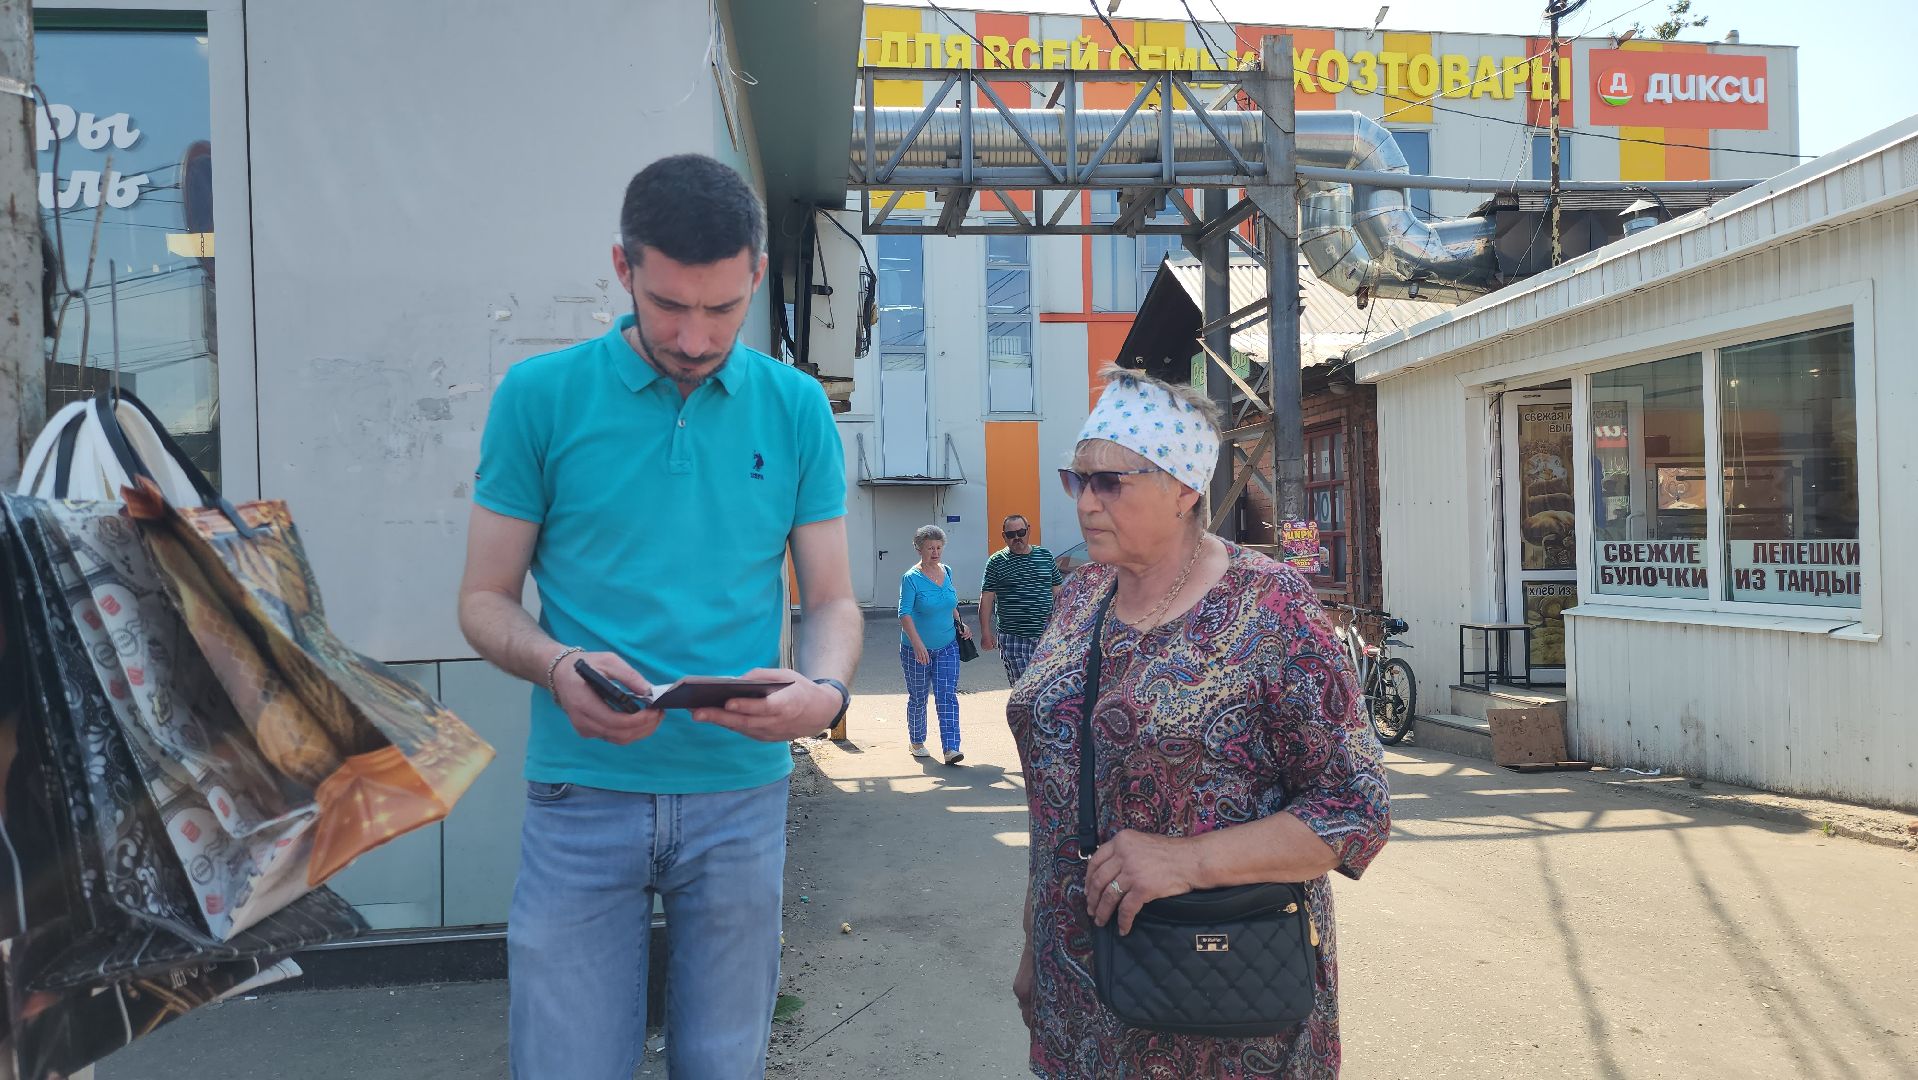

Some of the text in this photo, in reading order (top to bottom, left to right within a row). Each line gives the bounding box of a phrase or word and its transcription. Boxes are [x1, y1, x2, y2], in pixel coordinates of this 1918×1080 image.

[877, 31, 971, 70] ДЛЯ
[982, 36, 1098, 71] ВСЕЙ
[1293, 47, 1571, 101] ХОЗТОВАРЫ
[1524, 410, 1564, 422] свежая
[1603, 543, 1700, 564] СВЕЖИЕ
[1752, 542, 1860, 566] ЛЕПЕШКИ
[1600, 566, 1708, 588] БУЛОЧКИ
[1735, 567, 1766, 591] ИЗ
[1529, 585, 1571, 596] хлеб из
